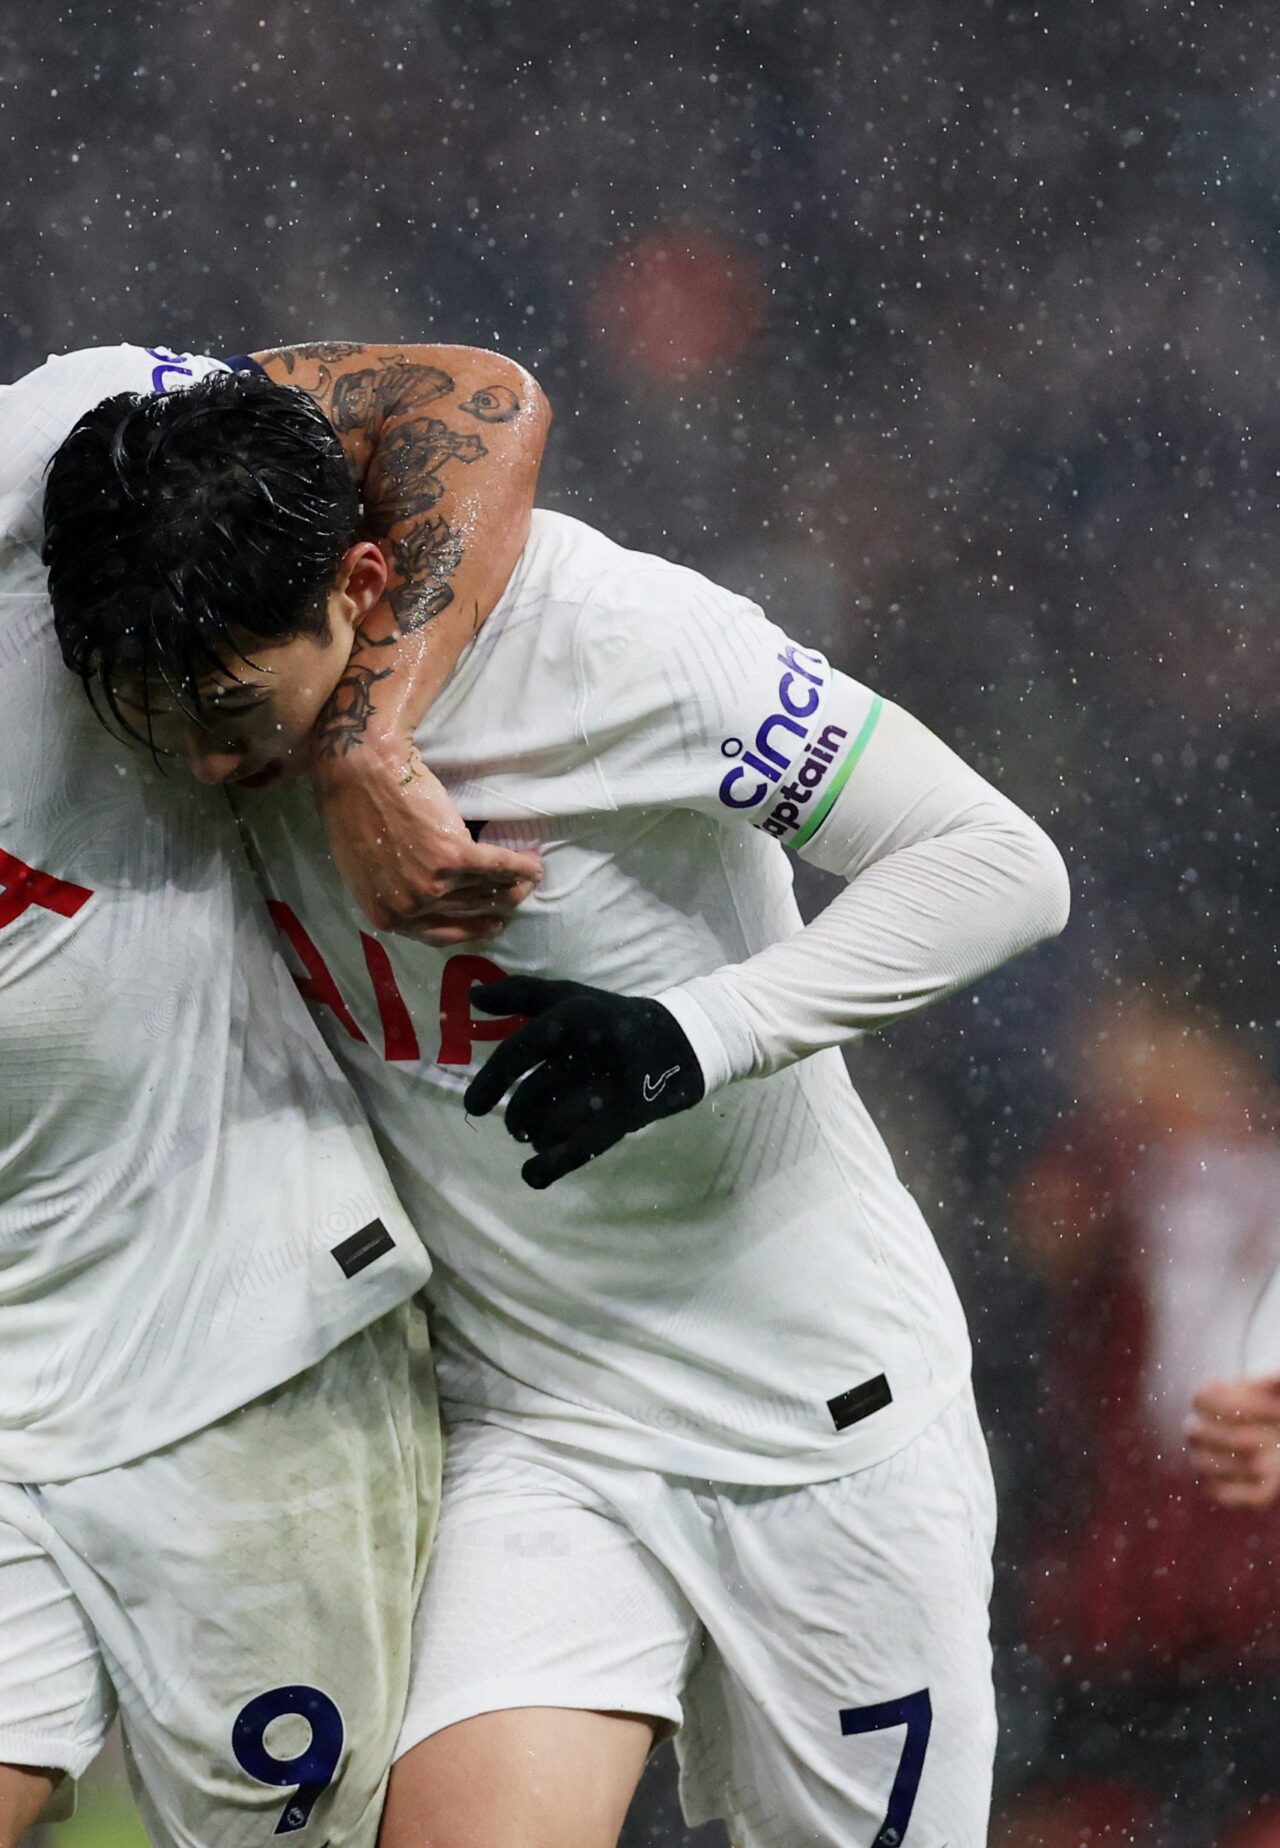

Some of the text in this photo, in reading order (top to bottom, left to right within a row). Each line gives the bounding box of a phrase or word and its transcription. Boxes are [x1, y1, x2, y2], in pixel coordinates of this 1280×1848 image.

[718, 645, 825, 810] cinch
[752, 724, 848, 840] aptain
[231, 1684, 345, 1836] 9
[838, 1686, 933, 1848] 7
